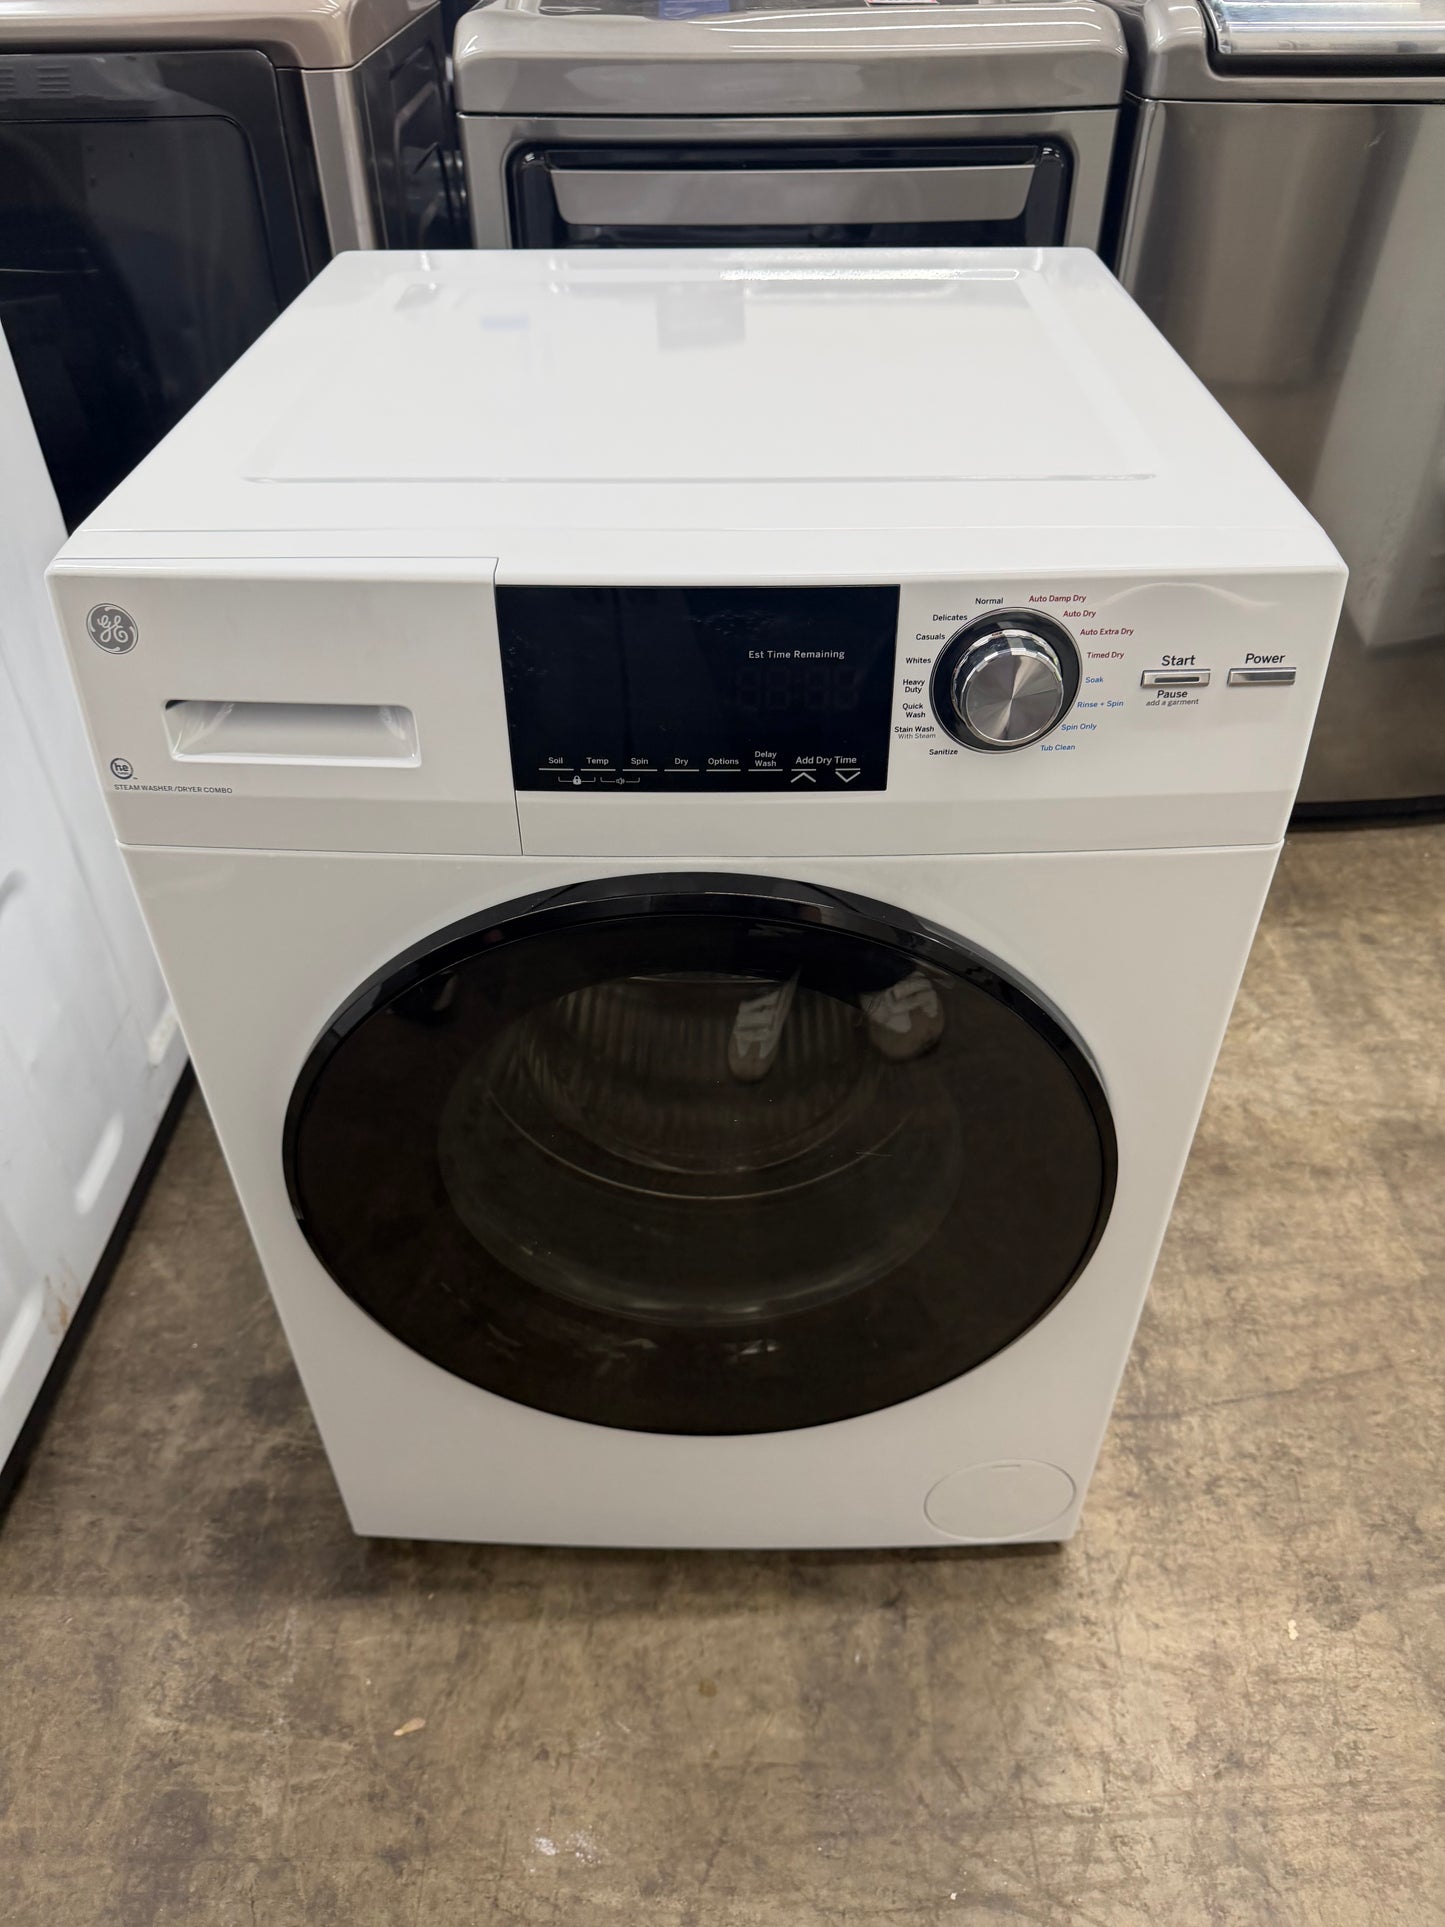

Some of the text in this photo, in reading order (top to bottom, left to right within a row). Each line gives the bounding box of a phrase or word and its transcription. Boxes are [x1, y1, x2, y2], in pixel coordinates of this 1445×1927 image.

[975, 597, 1003, 605] Normal
[1029, 594, 1087, 603] Auto Damp Dry
[932, 613, 968, 622] Delicates
[1063, 610, 1097, 618] Auto Dry
[916, 632, 945, 641] Casuals
[1080, 628, 1134, 636] Auto Extra Dry
[749, 649, 845, 660] Est Time Remaining
[1087, 651, 1124, 660] Timed Dry
[1245, 653, 1285, 665] Power
[906, 657, 931, 665] Whites
[1161, 654, 1195, 667] Start
[902, 679, 925, 687] Heavy
[1085, 676, 1104, 684] Soak
[904, 686, 922, 694] Duty
[1157, 689, 1188, 700] Pause
[902, 703, 924, 711] Quick
[1077, 701, 1098, 709] Rinse
[1107, 700, 1124, 709] Spin
[1168, 699, 1199, 707] garment
[906, 711, 926, 719] Wash
[1061, 723, 1097, 732] Spin Only
[929, 748, 958, 756] Sanitize
[1041, 744, 1076, 752] Tub Clean
[754, 750, 777, 760] Delay
[548, 757, 563, 765] Soil
[586, 757, 609, 766] Temp
[630, 757, 648, 766] Spin
[674, 757, 688, 766] Dry
[708, 757, 739, 766] Options
[755, 759, 777, 767] Wash
[795, 756, 856, 765] Add Dry Time
